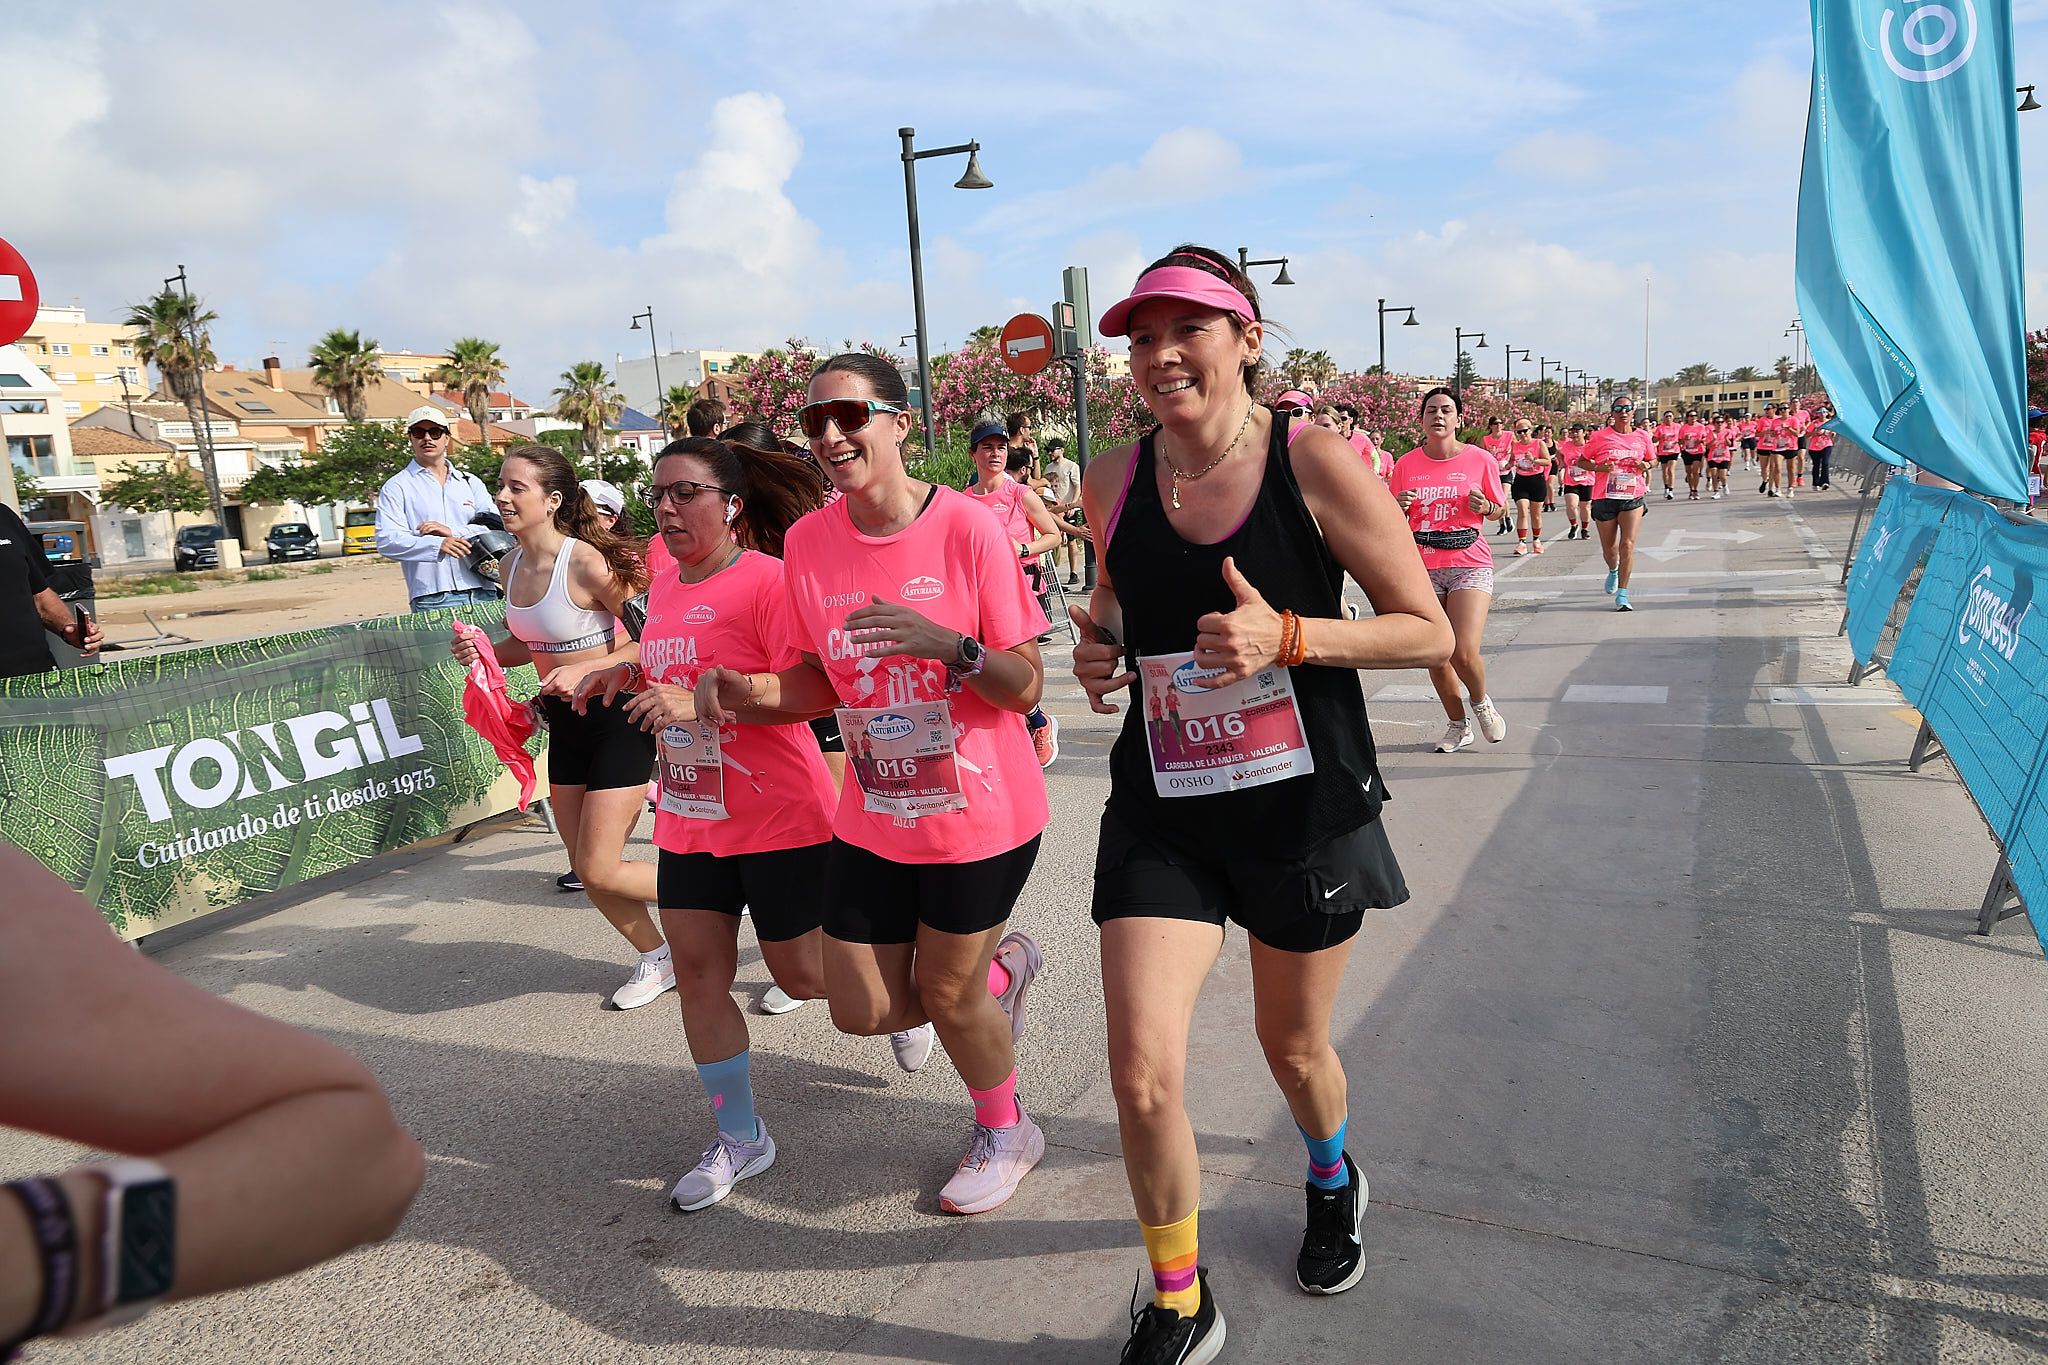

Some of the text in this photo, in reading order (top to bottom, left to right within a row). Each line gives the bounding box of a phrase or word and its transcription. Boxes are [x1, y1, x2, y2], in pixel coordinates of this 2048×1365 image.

[1415, 486, 1458, 500] ARRERA
[823, 590, 865, 609] OYSHO
[1959, 564, 2032, 661] Compeed
[641, 635, 699, 667] ARRERA
[870, 724, 911, 735] ASTURIANA
[1185, 712, 1245, 743] 016
[1165, 761, 1195, 770] CARRERA
[1195, 759, 1206, 768] DE
[1206, 758, 1217, 767] LA
[1217, 753, 1245, 765] MUJER
[1250, 741, 1289, 759] VALENCIA
[1205, 742, 1234, 756] 2343
[669, 763, 698, 782] 016
[876, 758, 917, 778] 016
[1244, 760, 1293, 779] Santander
[920, 786, 949, 796] VALENCIA
[1169, 774, 1214, 789] OYSHO
[916, 799, 952, 810] Santander
[136, 765, 438, 869] Cuidando de ti desde 1975
